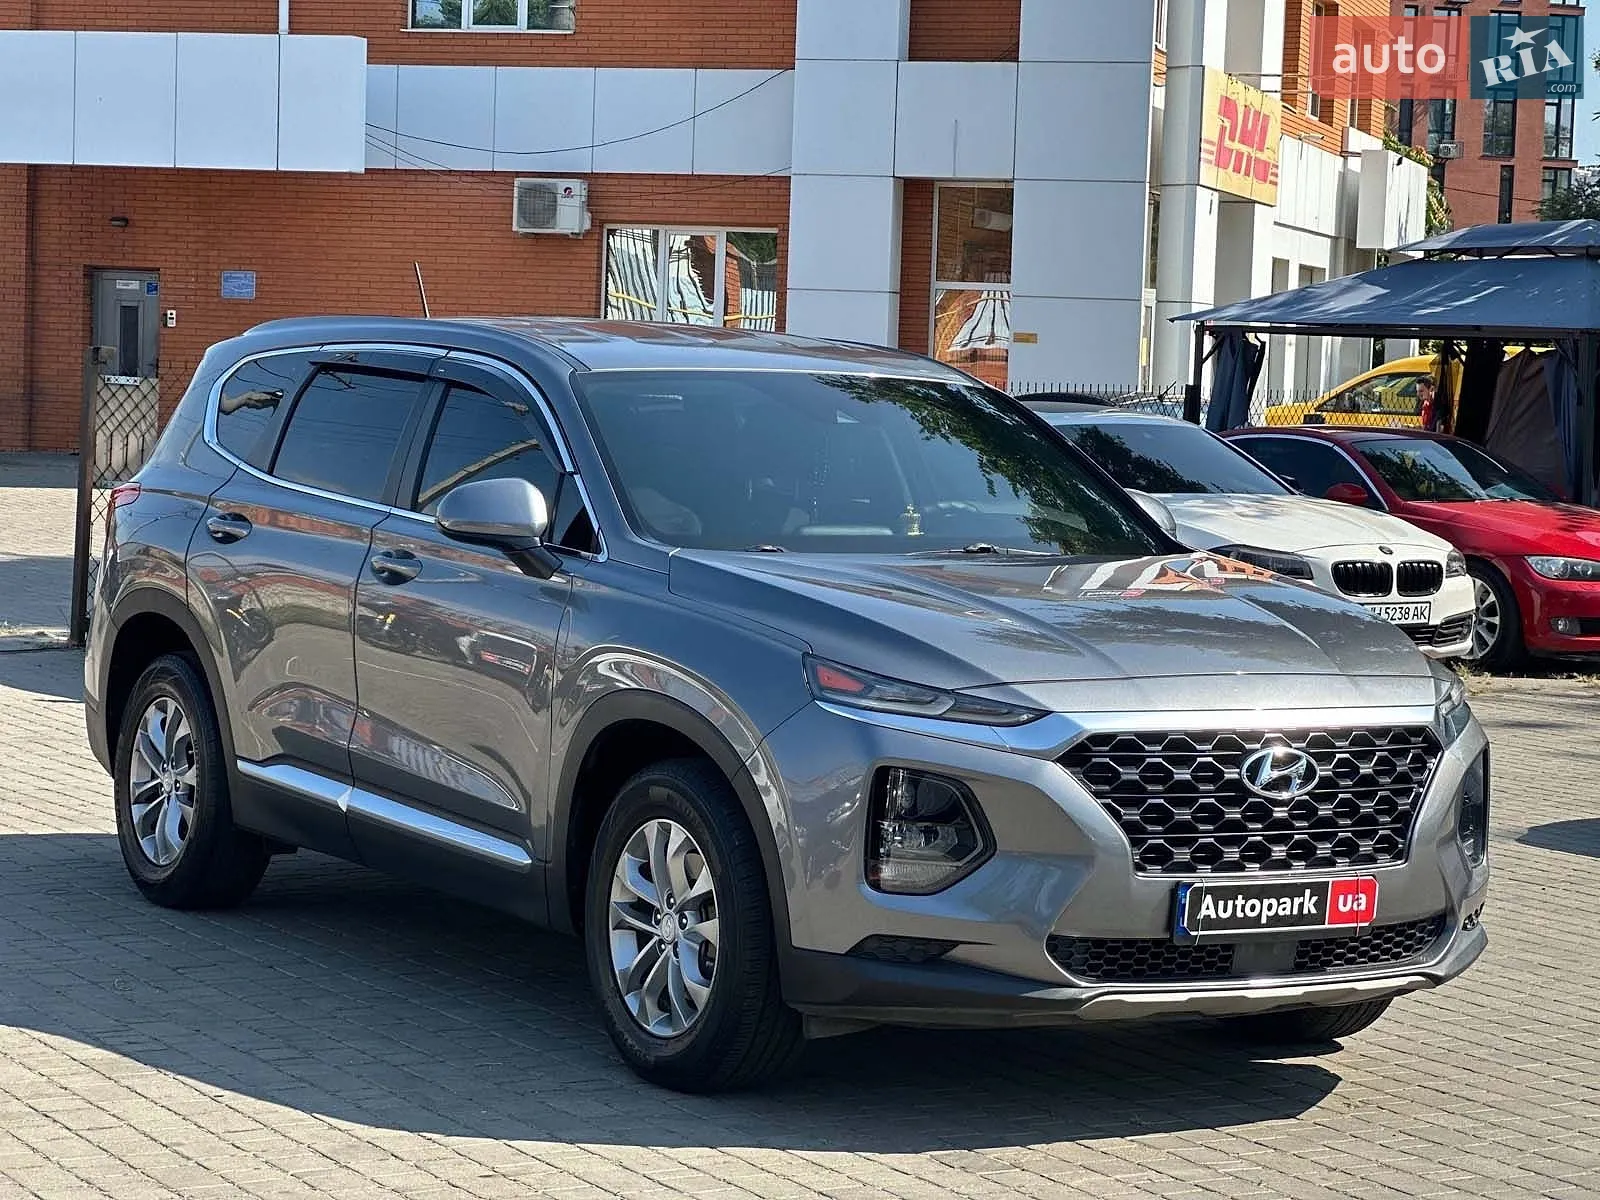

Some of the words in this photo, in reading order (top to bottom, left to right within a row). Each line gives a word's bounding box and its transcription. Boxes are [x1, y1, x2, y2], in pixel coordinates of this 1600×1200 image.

[1214, 95, 1271, 184] DHL
[1385, 606, 1410, 621] 5238
[1412, 605, 1428, 620] AK
[1197, 889, 1319, 924] Autopark
[1338, 892, 1367, 913] ua
